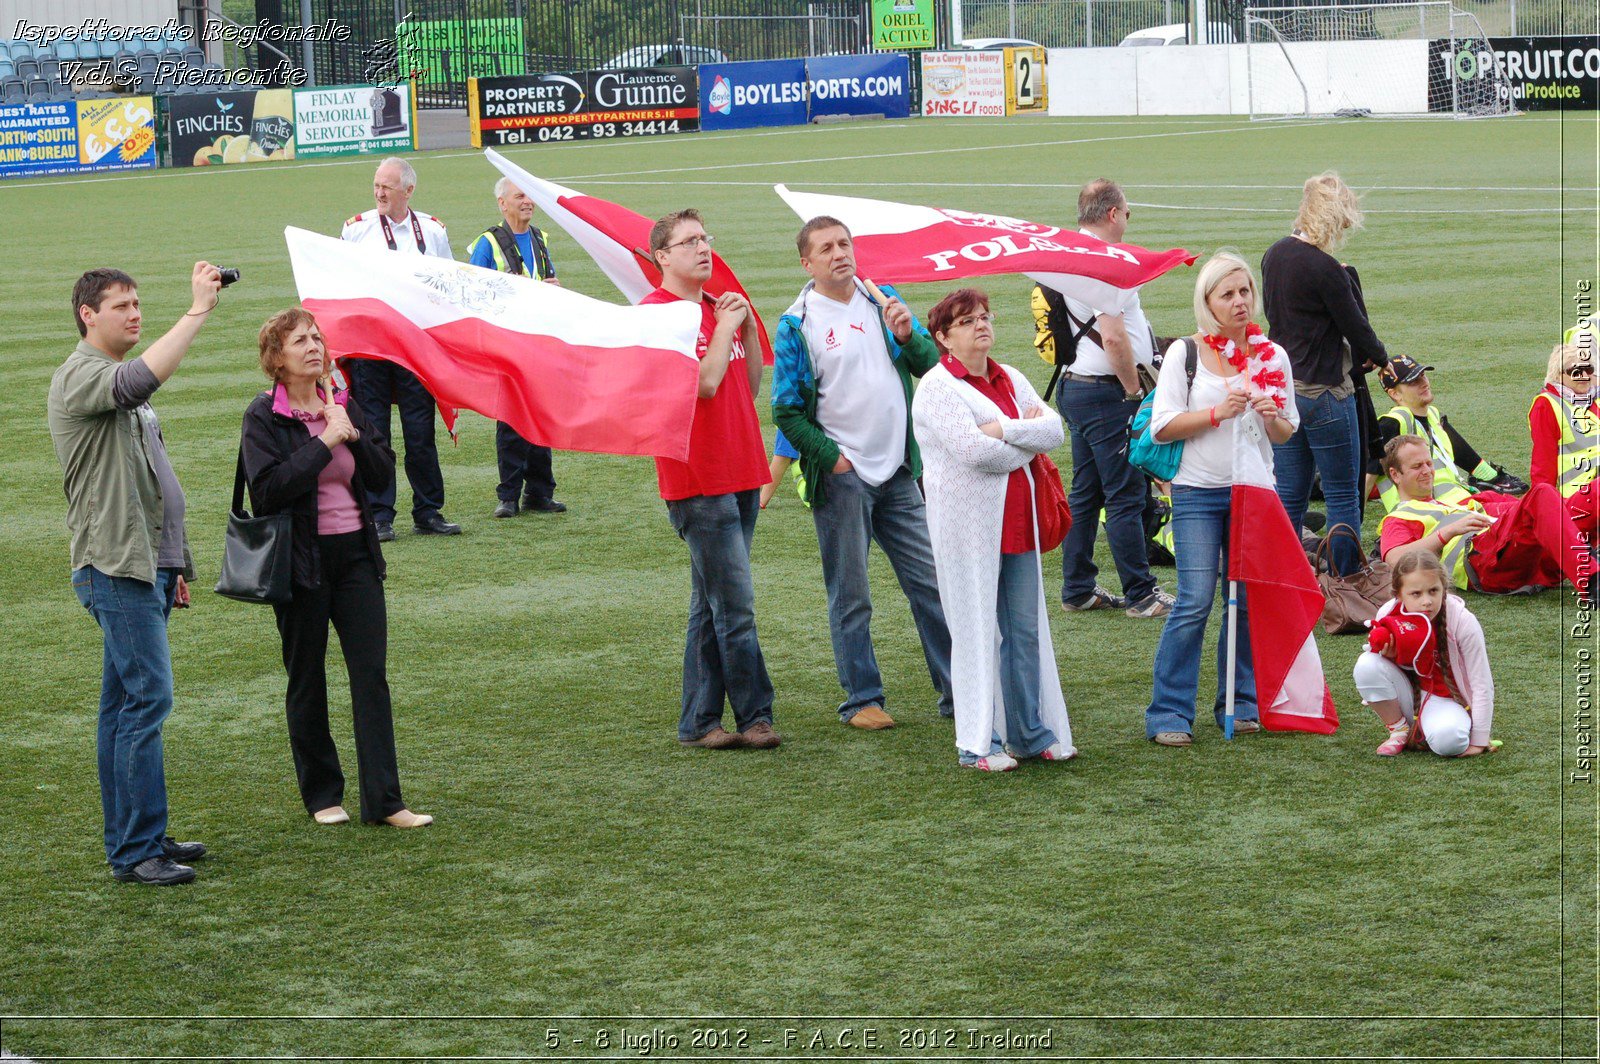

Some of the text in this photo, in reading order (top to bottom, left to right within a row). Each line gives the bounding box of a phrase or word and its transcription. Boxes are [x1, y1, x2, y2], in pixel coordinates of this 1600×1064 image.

[883, 14, 924, 26] ORIEL
[880, 29, 929, 43] ACTIVE
[924, 54, 935, 63] For
[942, 54, 962, 64] Curry
[980, 53, 1000, 64] Hurry
[620, 74, 676, 85] Laurence
[1020, 57, 1031, 97] 2
[486, 86, 564, 101] PROPERTY
[595, 74, 686, 107] Gunne
[712, 91, 730, 103] Boyle
[734, 76, 902, 106] BOYLESPORTS.COM
[311, 92, 356, 106] FINLAY
[29, 106, 66, 115] RATES
[81, 106, 97, 120] ALL
[90, 102, 112, 120] MAJOR
[91, 102, 122, 126] CURRENCIES
[486, 100, 566, 116] PARTNERS
[926, 100, 1002, 115] SING LI FOODS
[299, 108, 370, 124] MEMORIAL
[501, 110, 675, 127] WWW.PROPERTYPARTNERS.IE
[176, 115, 242, 136] FINCHES
[255, 122, 290, 139] FINCHES
[306, 125, 364, 140] SERVICES
[496, 130, 531, 144] Tel.
[539, 126, 574, 142] 042
[594, 122, 616, 138] 93
[622, 120, 680, 136] 34414
[125, 130, 149, 151] 0%
[298, 144, 358, 154] www.finlaygrp.com
